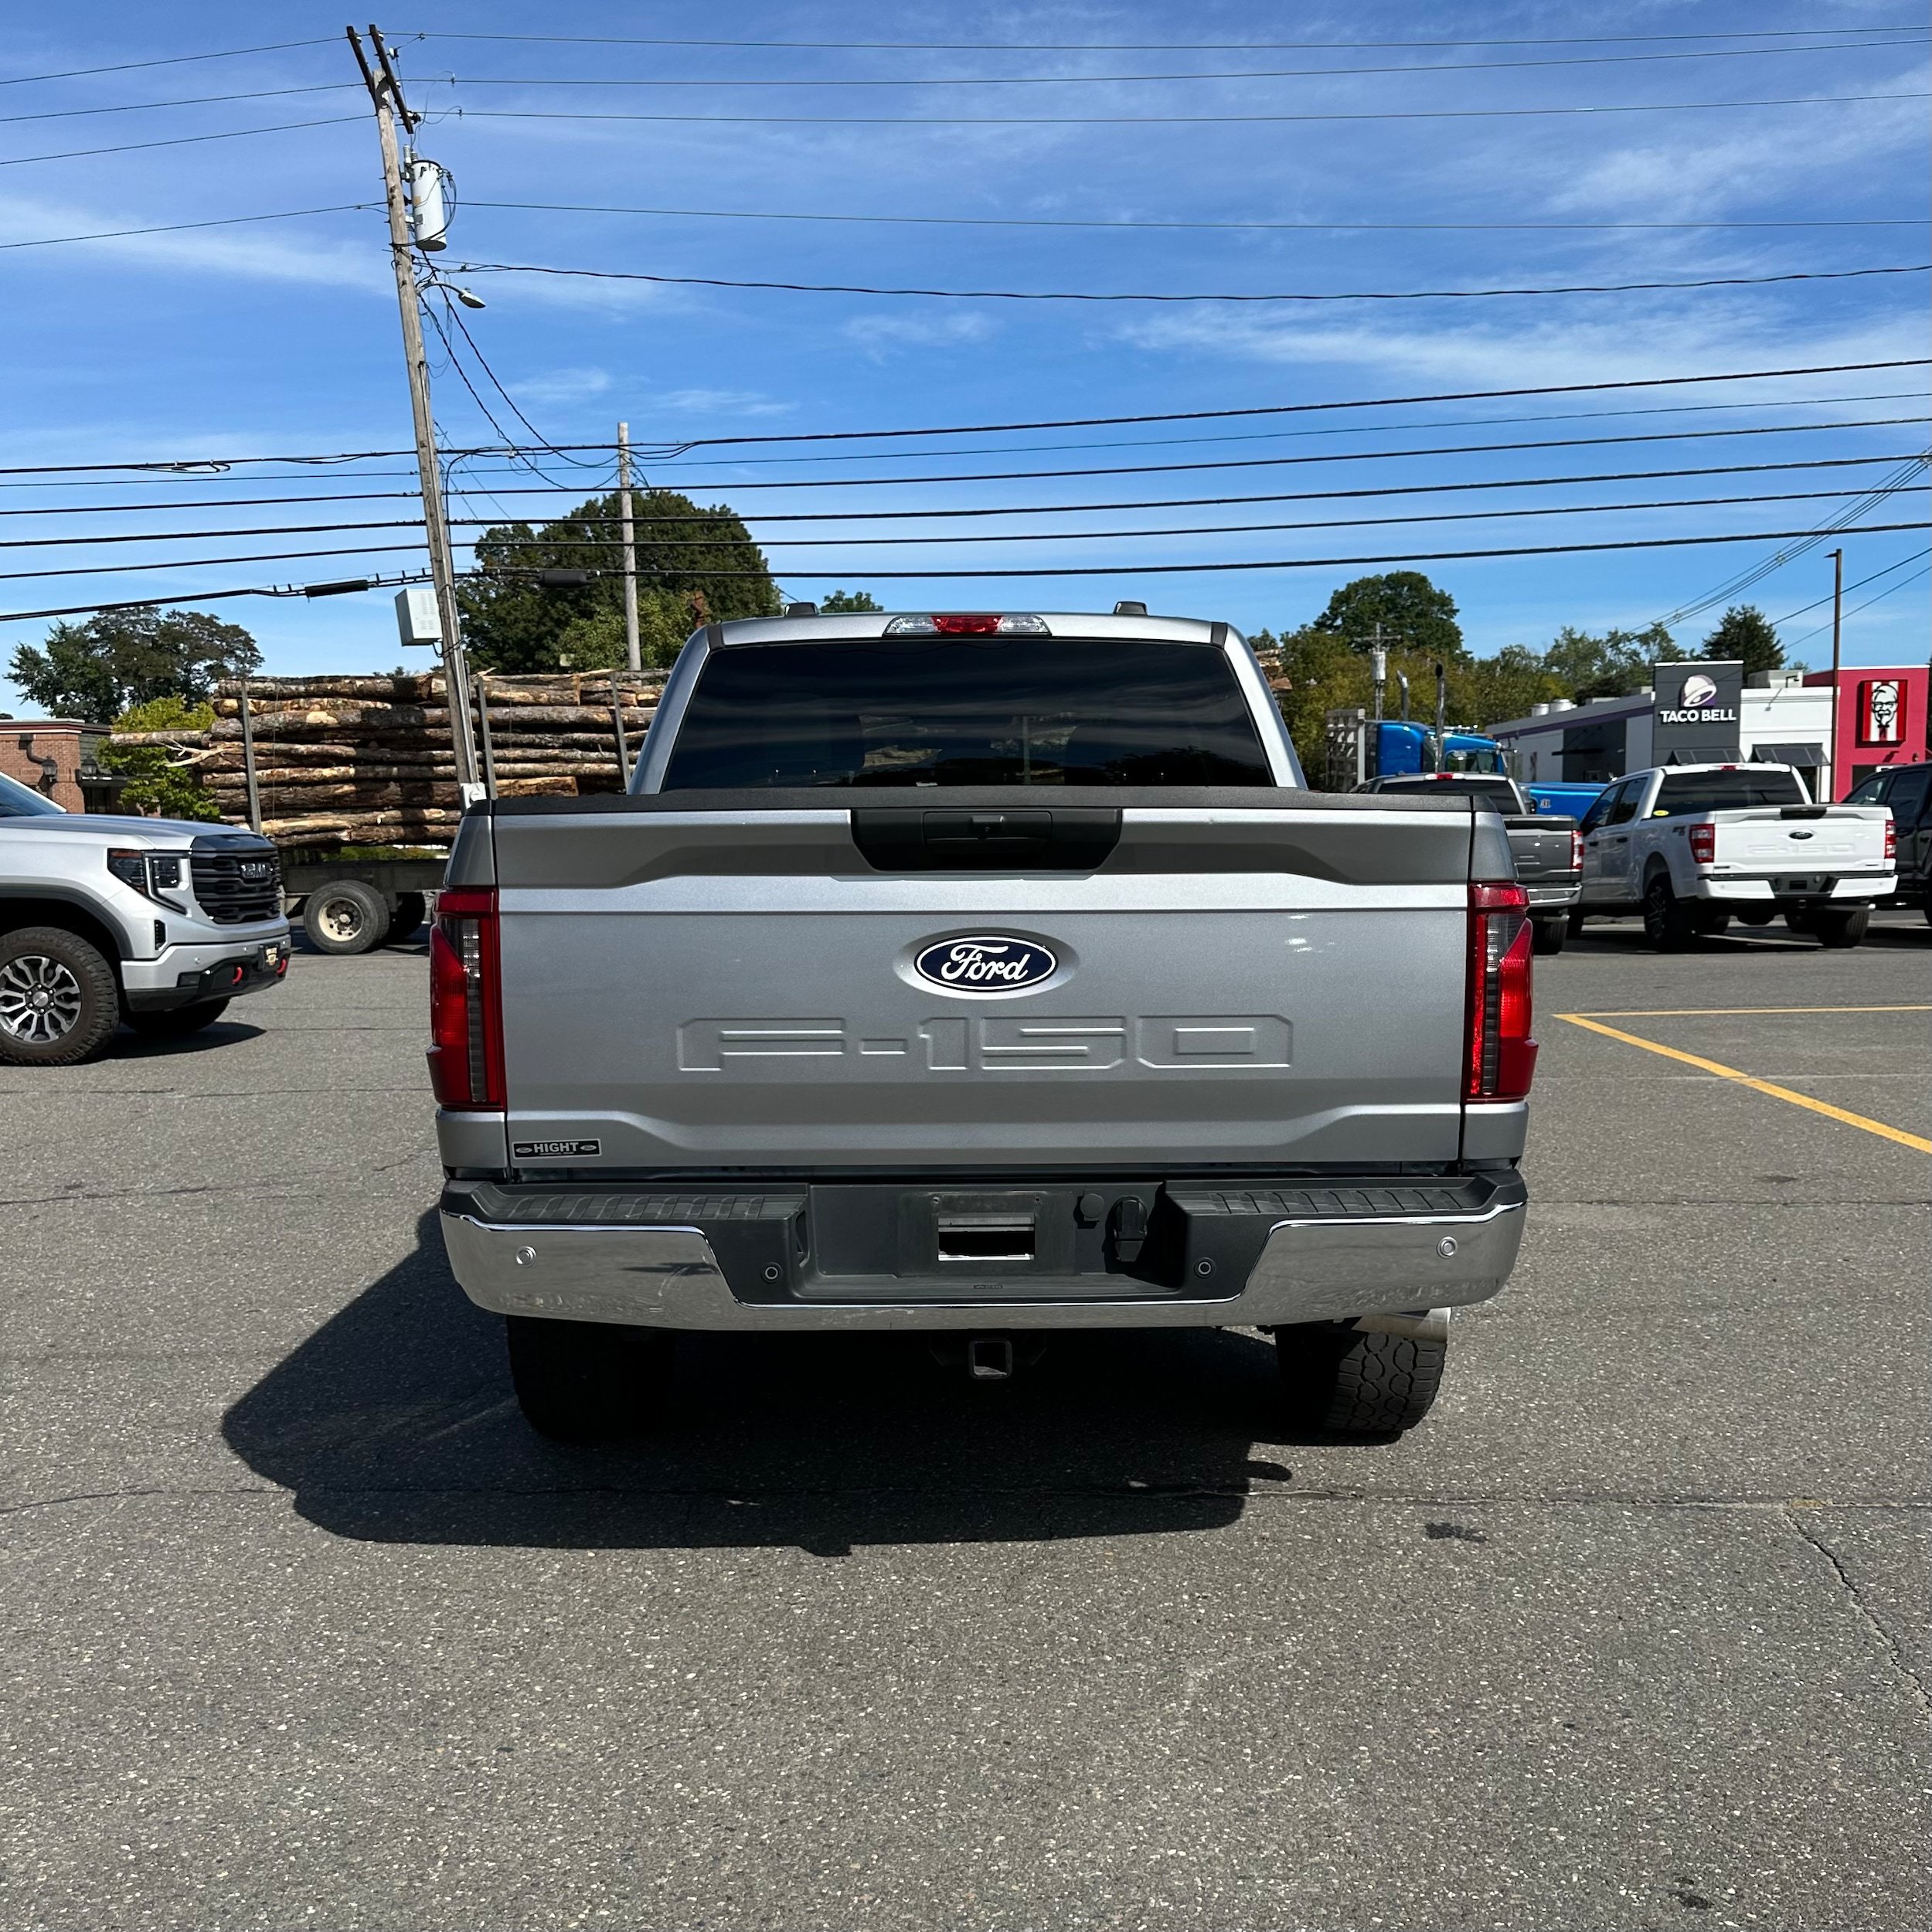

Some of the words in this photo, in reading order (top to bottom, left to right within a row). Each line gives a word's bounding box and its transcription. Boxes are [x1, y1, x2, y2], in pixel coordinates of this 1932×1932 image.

[1660, 709, 1699, 723] TACO
[1702, 709, 1736, 722] BELL
[940, 944, 1029, 980] Ford
[676, 1015, 1295, 1072] F-150
[533, 1142, 579, 1153] HIGHT
